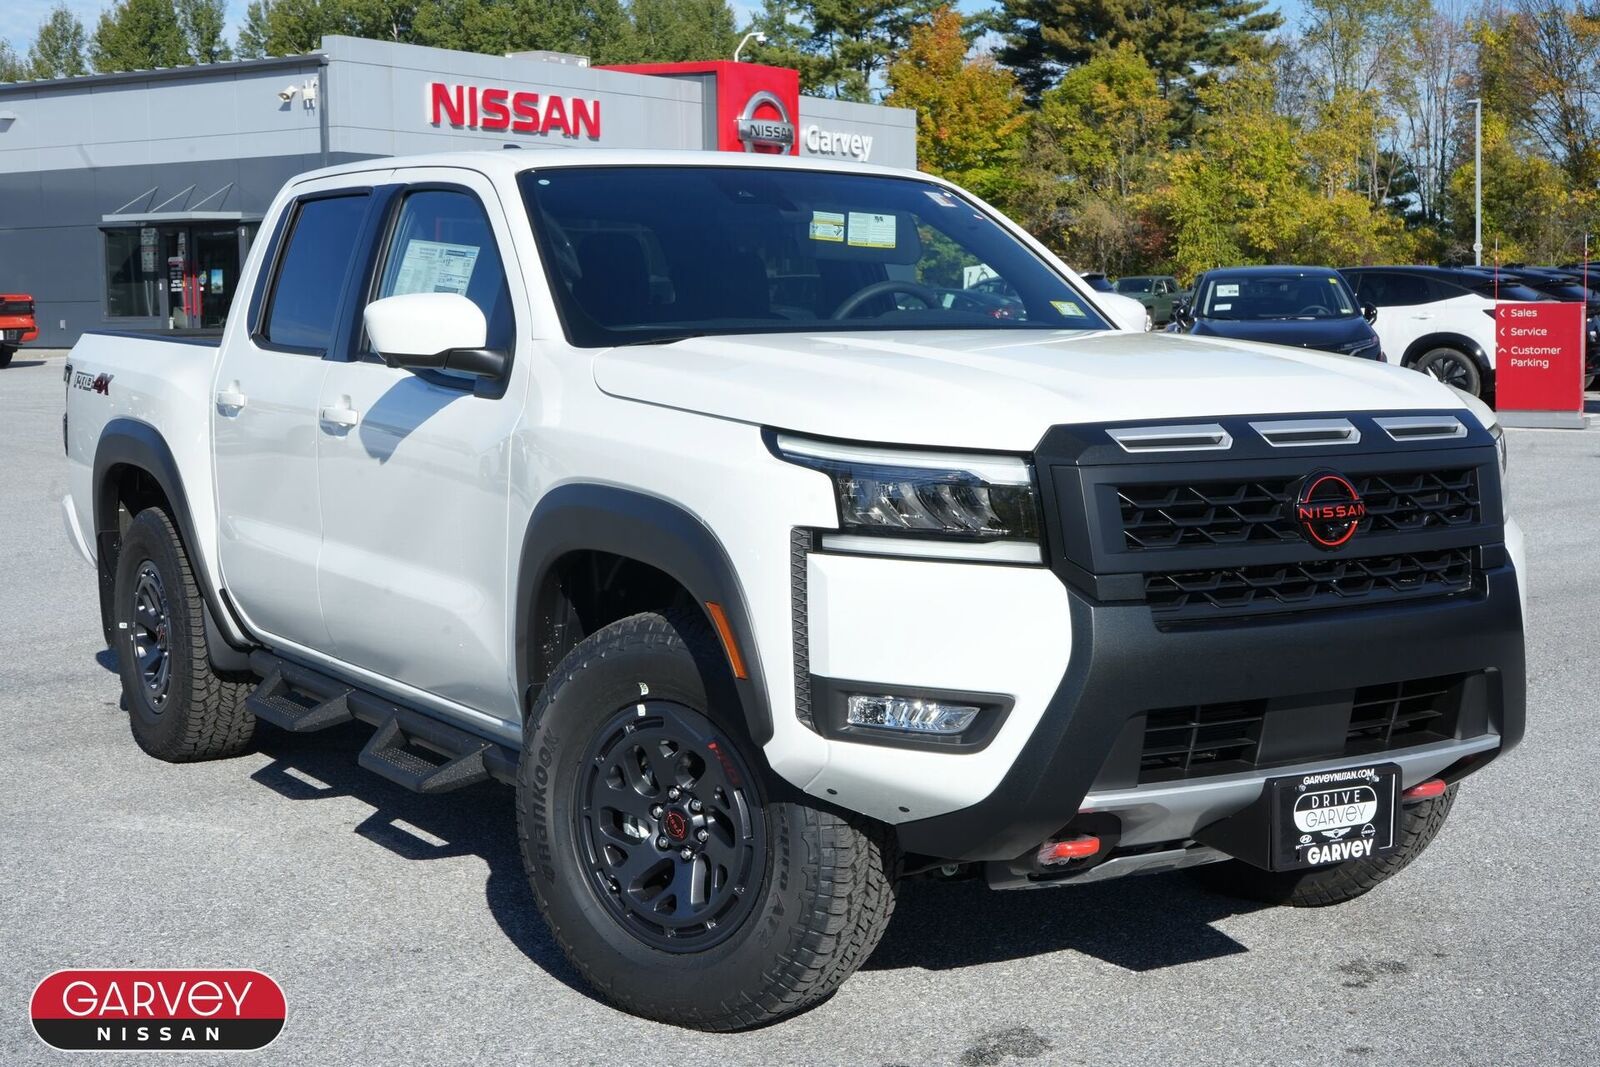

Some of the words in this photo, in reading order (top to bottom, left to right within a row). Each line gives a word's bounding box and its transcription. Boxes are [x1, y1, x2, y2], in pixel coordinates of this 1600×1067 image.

[431, 82, 600, 140] NISSAN
[806, 124, 873, 161] Garvey
[1510, 308, 1538, 318] Sales
[1510, 327, 1548, 336] Service
[1510, 346, 1562, 355] Customer
[1510, 358, 1549, 369] Parking
[1299, 504, 1366, 519] NISSAN
[1311, 790, 1361, 809] DRIVE
